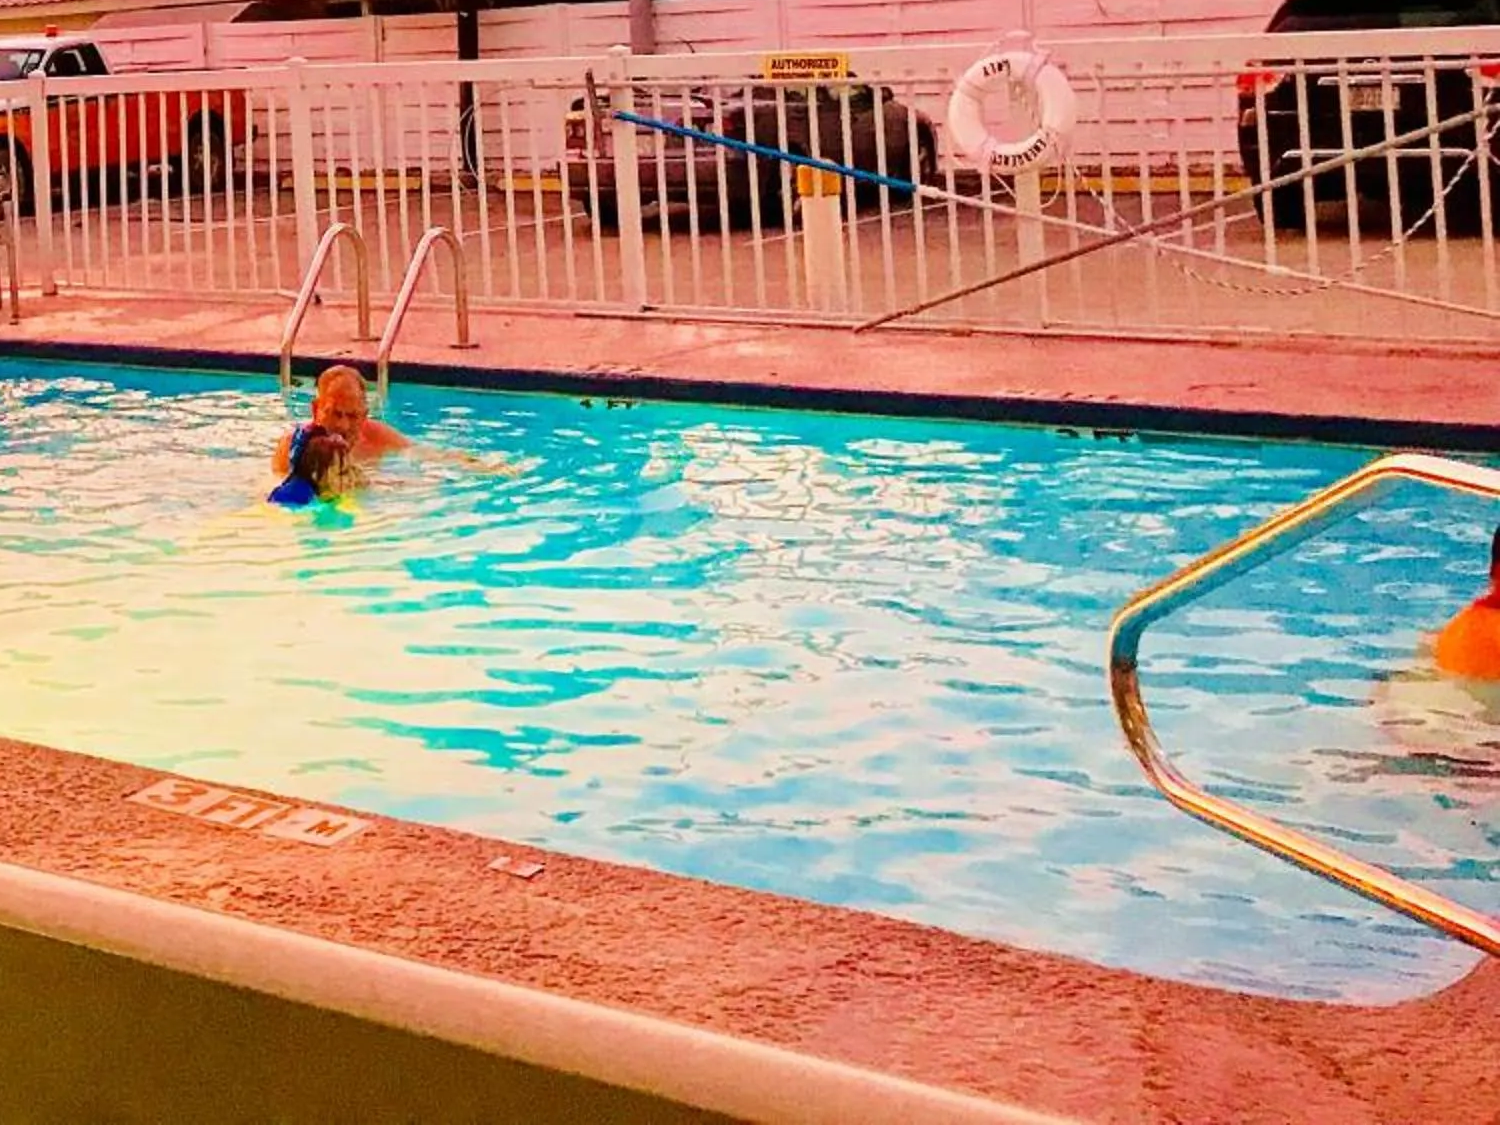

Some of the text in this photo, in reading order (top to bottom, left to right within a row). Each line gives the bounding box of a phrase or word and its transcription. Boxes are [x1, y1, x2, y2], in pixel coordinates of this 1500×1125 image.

[770, 57, 840, 71] AUTHORIZED
[146, 782, 209, 806] 3
[198, 793, 282, 826] FT
